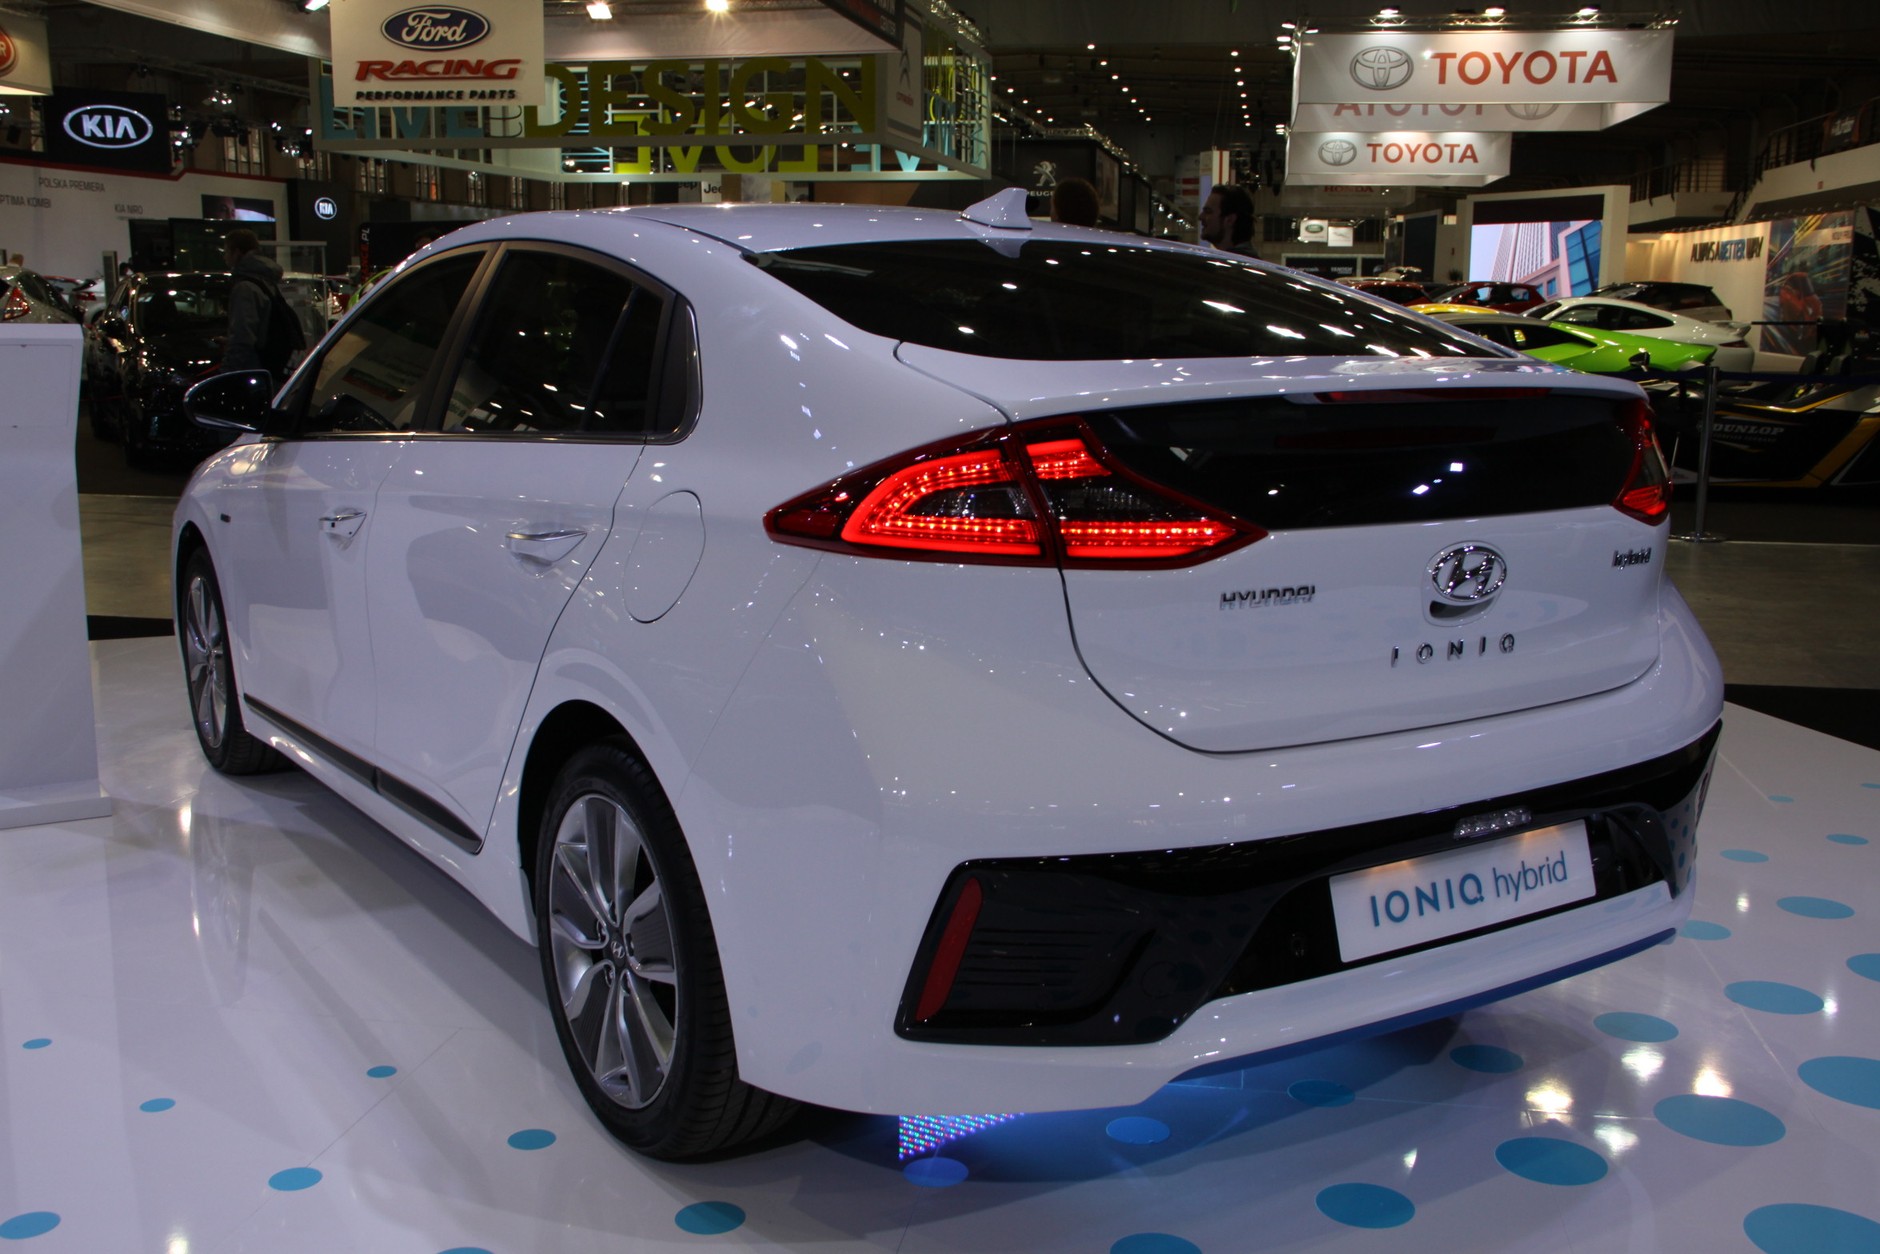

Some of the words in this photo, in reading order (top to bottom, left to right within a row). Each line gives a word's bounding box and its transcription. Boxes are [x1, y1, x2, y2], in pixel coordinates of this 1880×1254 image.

[401, 11, 468, 43] Ford
[355, 58, 522, 82] RACING
[1431, 50, 1618, 85] TOYOTA
[356, 90, 464, 101] PERFORMANCE
[469, 89, 517, 100] PARTS
[524, 57, 876, 138] DESIGN
[81, 114, 138, 140] KIA
[1367, 143, 1478, 164] TOYOTA
[38, 177, 68, 190] POLSKA
[69, 179, 105, 193] PREMIERA
[704, 184, 723, 194] Jee
[0, 195, 25, 207] PTIMA
[27, 197, 52, 209] KOMBI
[114, 203, 126, 214] KIA
[318, 202, 334, 215] KIA
[1690, 242, 1716, 263] ALWAYS
[1720, 238, 1746, 262] BETTER
[1745, 236, 1763, 260] WAY
[1712, 423, 1785, 436] DUNLOP
[1219, 584, 1317, 611] HYUNDAI
[1390, 632, 1517, 668] IONIQ
[1370, 873, 1485, 928] IONIQ
[1493, 850, 1568, 902] hybrid
